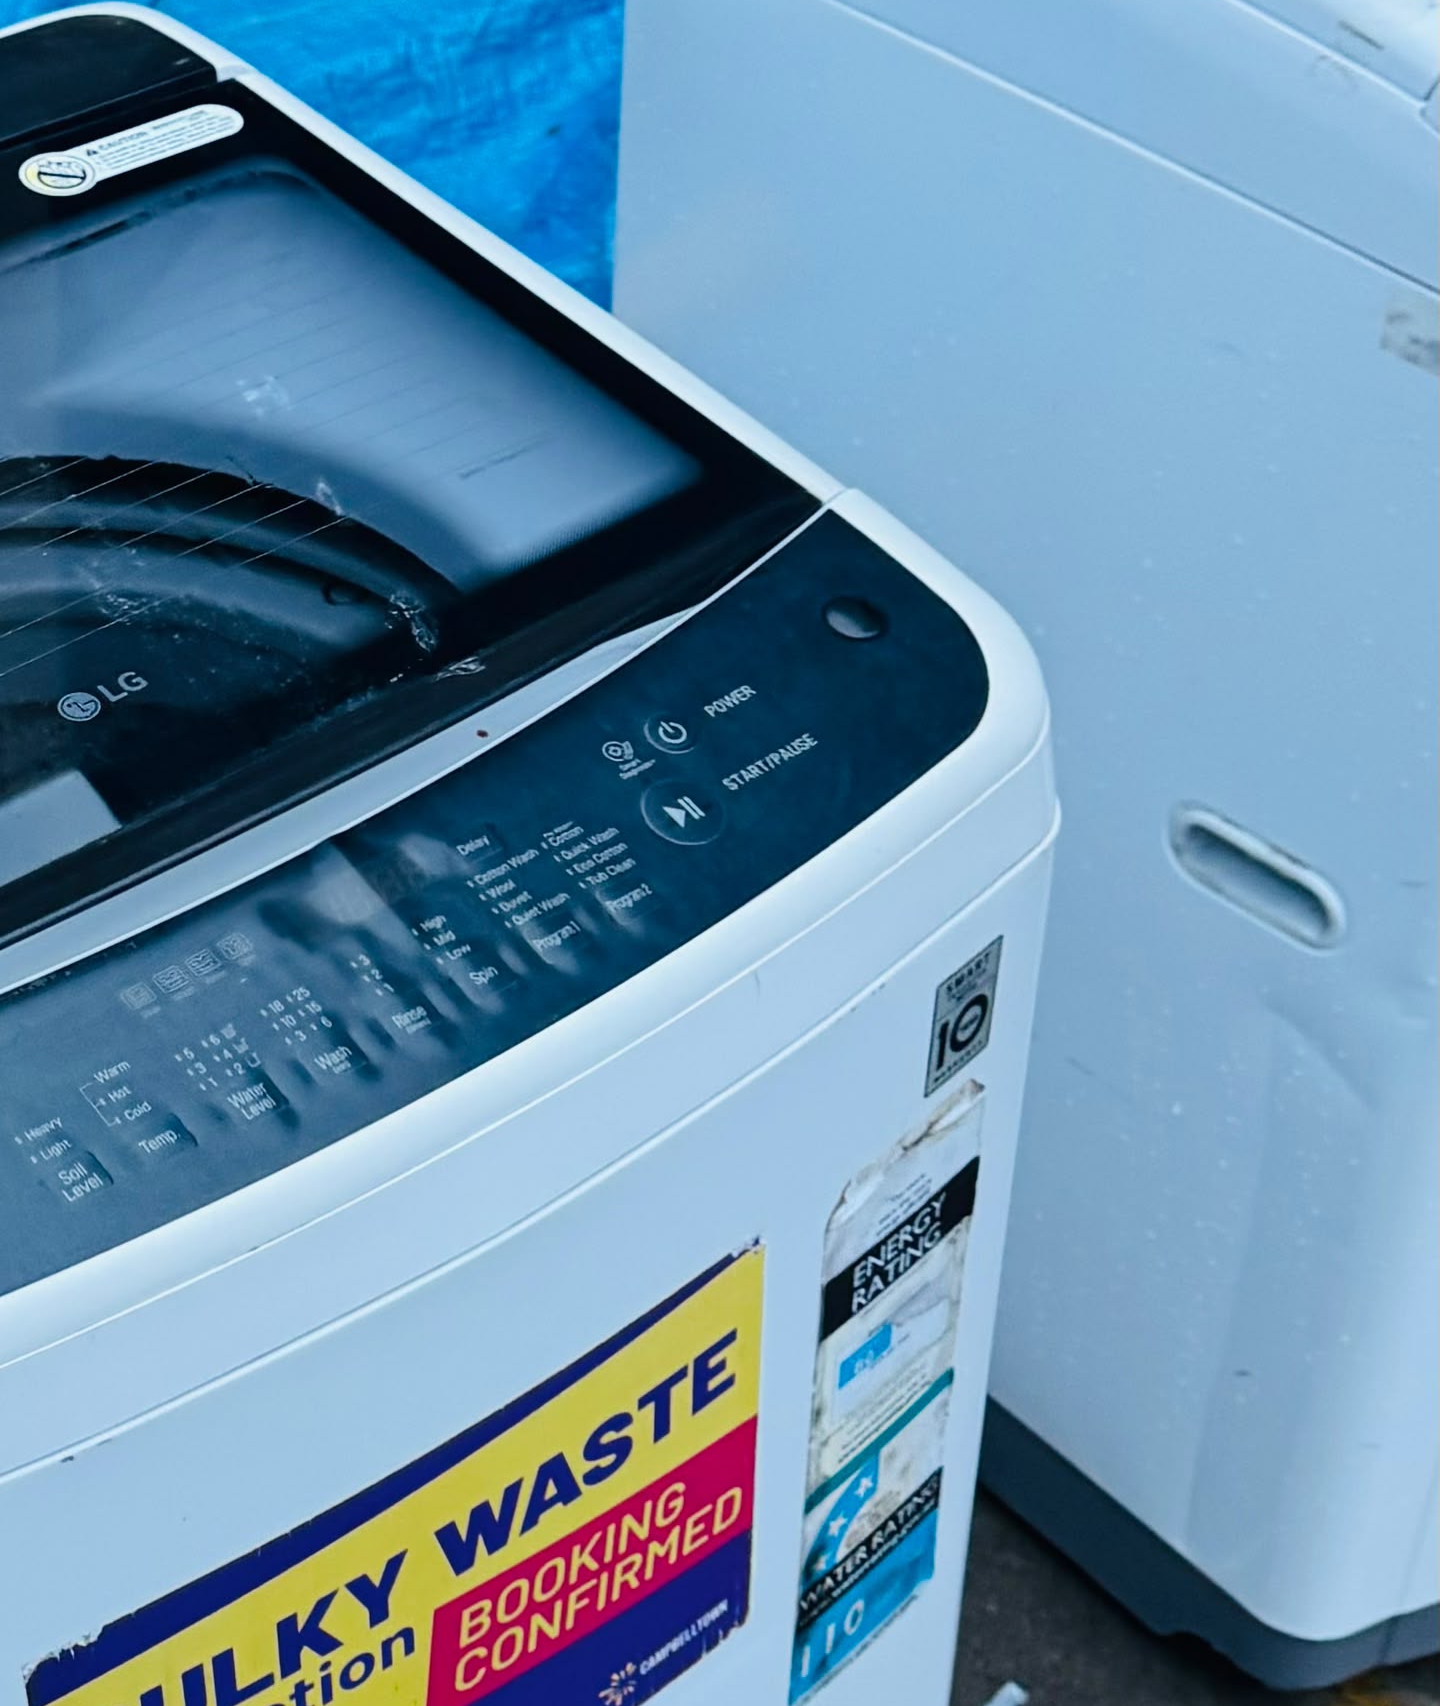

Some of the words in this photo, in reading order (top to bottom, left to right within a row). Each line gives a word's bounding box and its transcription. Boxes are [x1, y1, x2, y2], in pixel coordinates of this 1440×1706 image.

[97, 671, 149, 702] LG
[704, 685, 756, 717] POWER
[722, 733, 818, 791] START/PAUSE
[456, 835, 491, 857] Delay
[420, 913, 447, 933] High
[359, 954, 371, 966] 3
[445, 944, 472, 961] Low
[371, 969, 383, 981] 2
[469, 965, 499, 986] Spin
[267, 1000, 285, 1014] 18
[293, 986, 312, 1001] 25
[280, 1015, 297, 1028] 10
[392, 1005, 428, 1031] Rinse
[195, 1062, 207, 1075] 3
[233, 1063, 246, 1075] 2
[314, 1045, 353, 1071] Wash
[93, 1060, 131, 1084] Warm
[108, 1085, 132, 1103] Hot
[227, 1081, 267, 1110] Water
[123, 1100, 152, 1122] Cold
[241, 1095, 276, 1121] Level
[24, 1116, 63, 1142] Heavy
[138, 1129, 181, 1155] Temp.
[40, 1138, 72, 1162] Light
[58, 1161, 88, 1185] Soil
[62, 1174, 103, 1202] Level
[853, 1192, 946, 1288] ENERGY
[852, 1221, 941, 1313] RATING
[434, 1328, 737, 1576] WASTE
[460, 1482, 686, 1648] BOOKING
[800, 1546, 868, 1610] WATER
[455, 1487, 742, 1691] CONFIRMED
